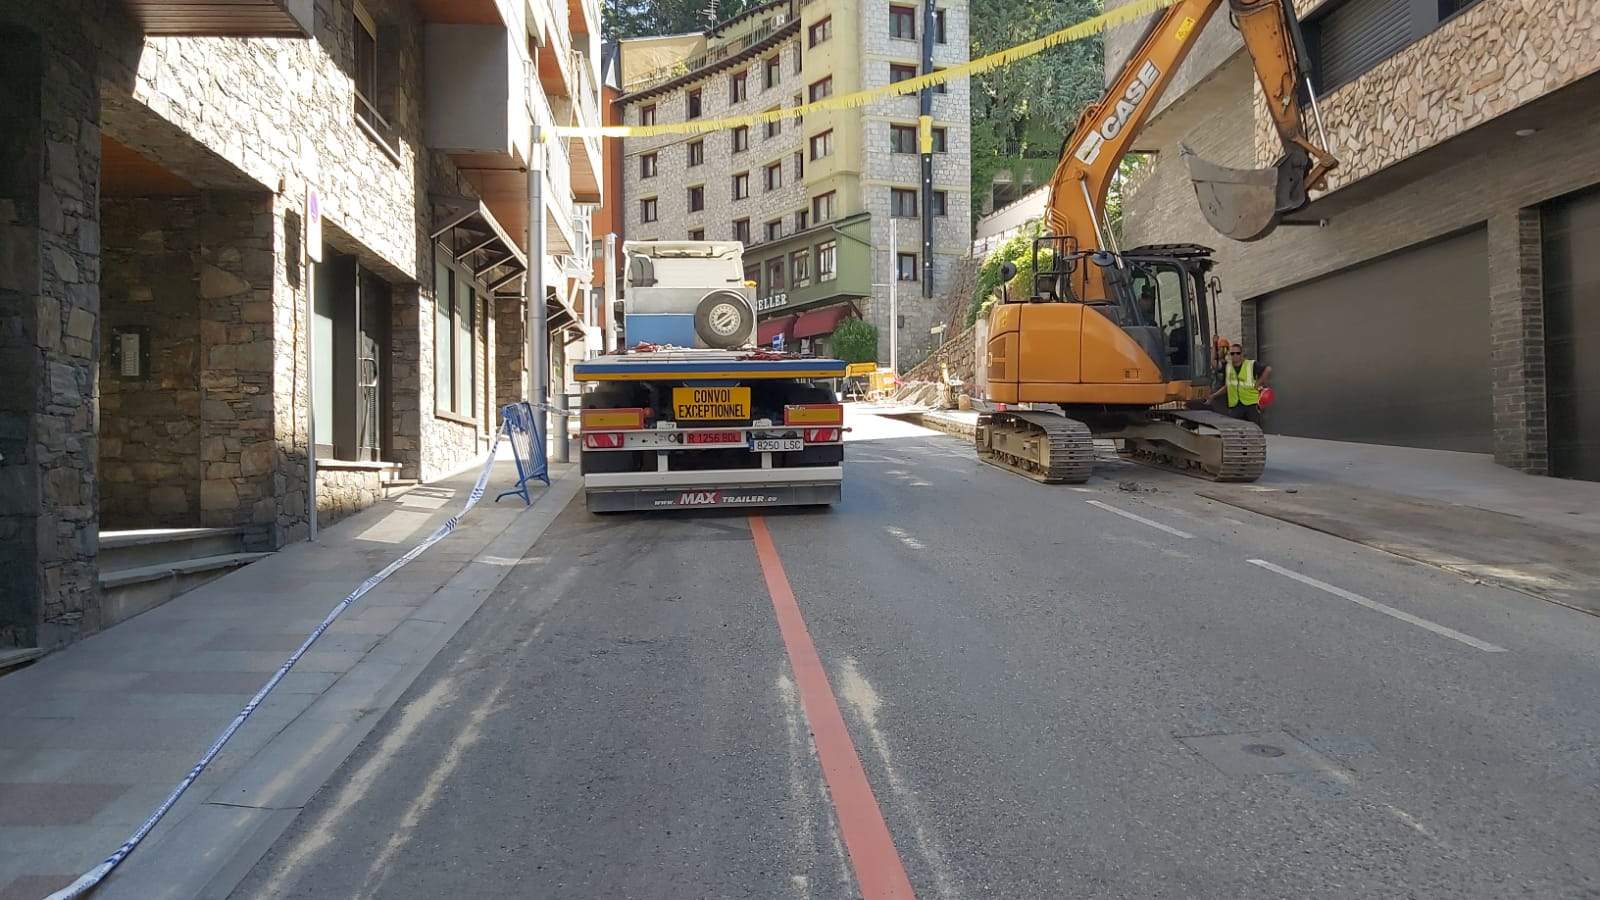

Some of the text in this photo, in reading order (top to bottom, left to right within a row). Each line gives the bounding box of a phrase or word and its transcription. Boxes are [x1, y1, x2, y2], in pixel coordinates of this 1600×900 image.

[1101, 59, 1161, 140] CASE
[756, 294, 787, 311] ELLER
[694, 389, 731, 403] CONVOI
[678, 404, 746, 418] EXCEPTIONNEL
[688, 432, 695, 443] R
[698, 431, 720, 443] 1256
[757, 440, 801, 450] 8250 LSC
[680, 492, 717, 505] MAX
